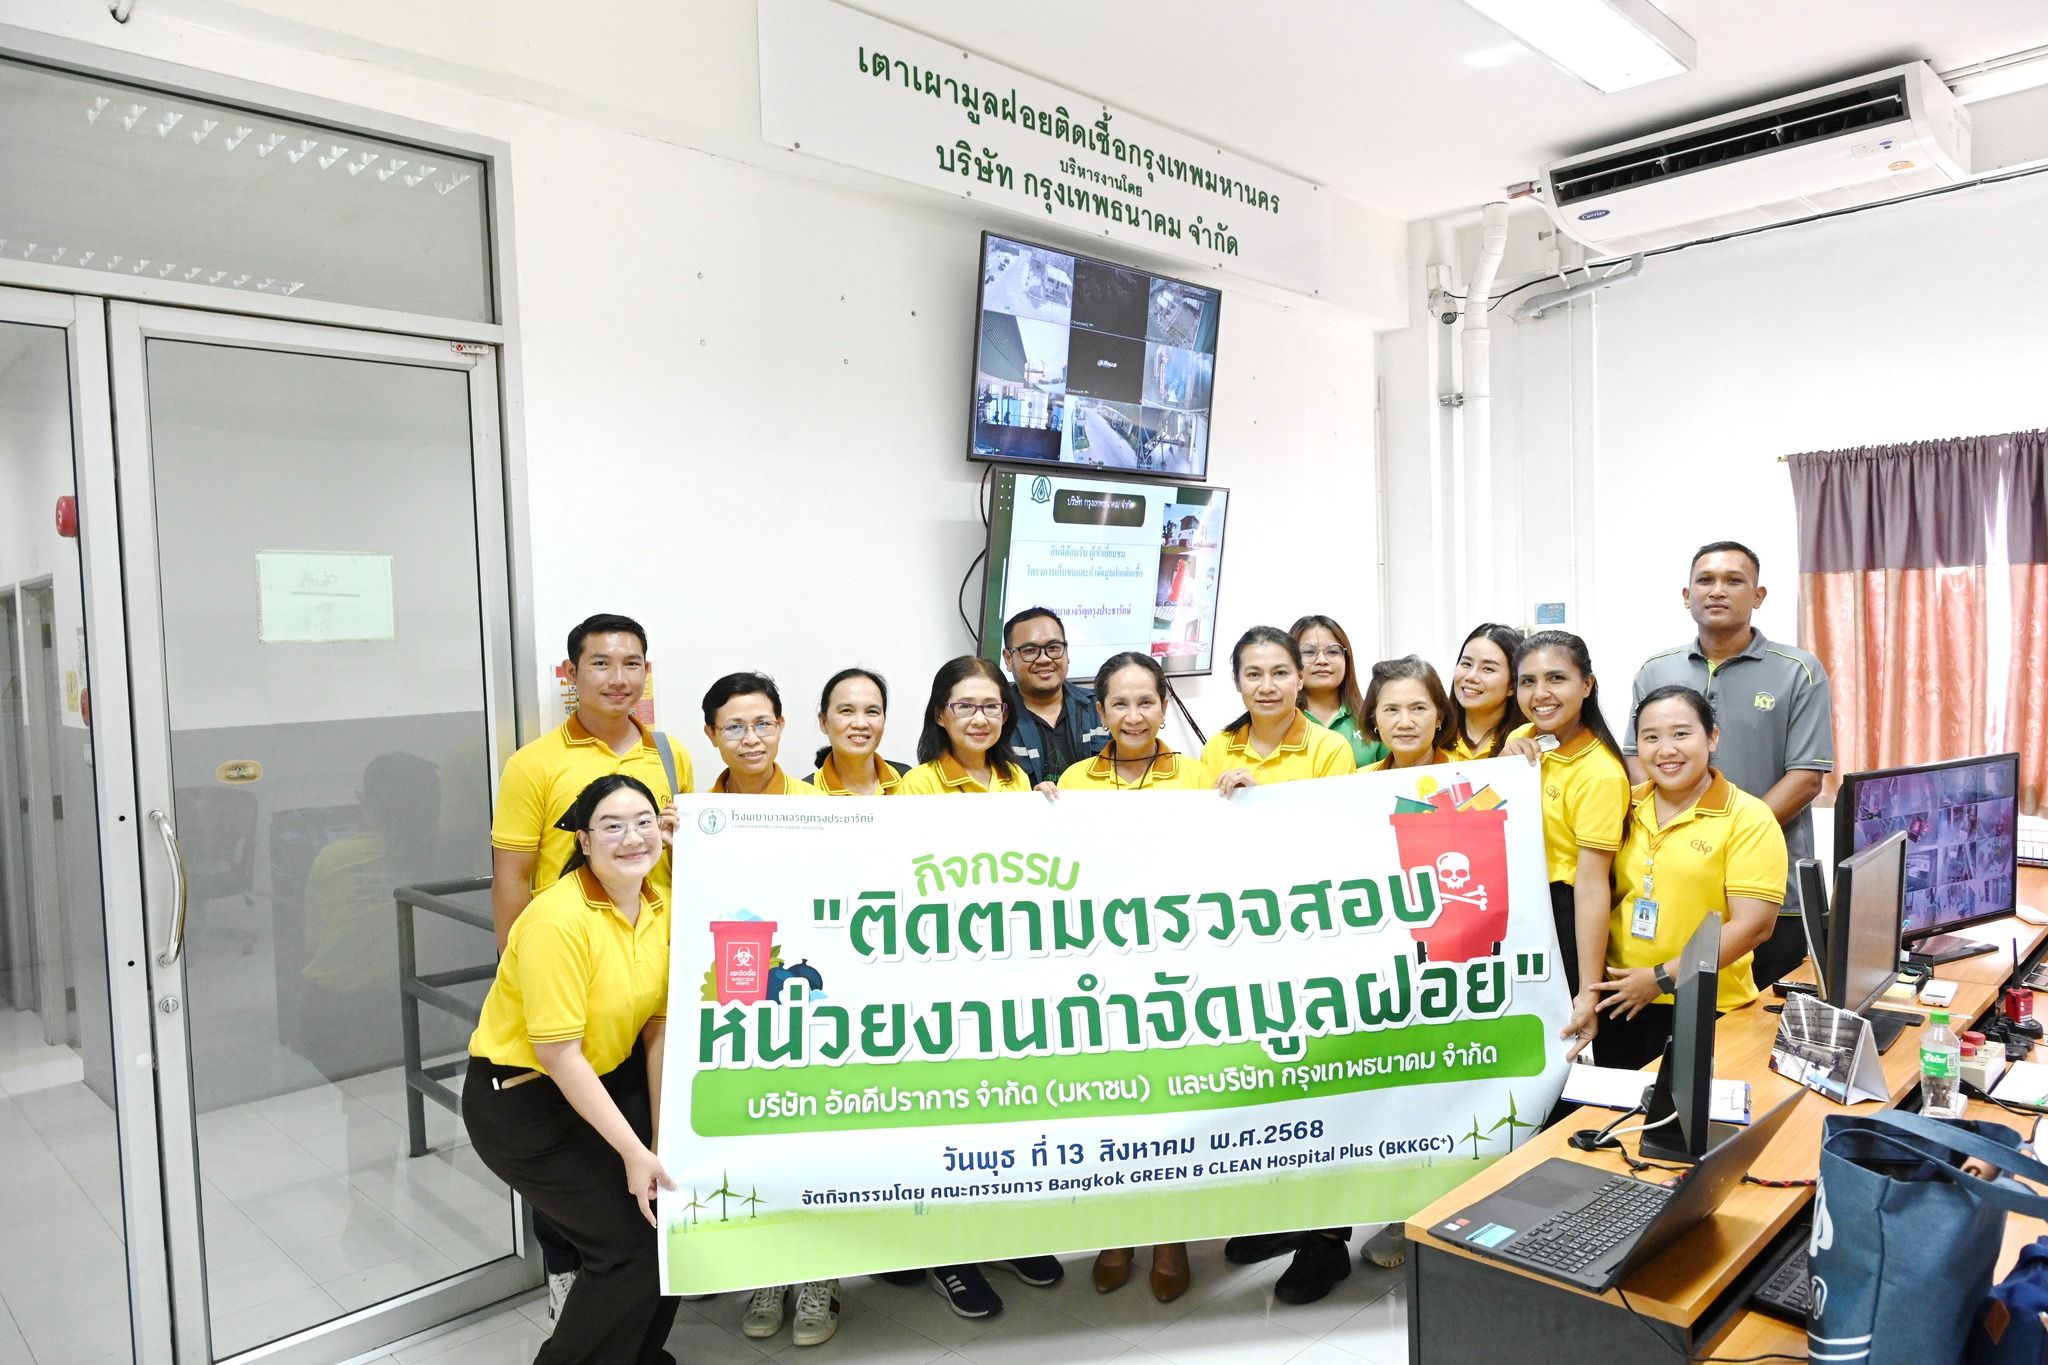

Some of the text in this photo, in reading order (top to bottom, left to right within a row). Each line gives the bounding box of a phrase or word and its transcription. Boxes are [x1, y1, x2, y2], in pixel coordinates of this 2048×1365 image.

[858, 45, 1281, 214] เตาเผามูลฝอยติดเชื้อกรุงเทพมหานคร
[935, 139, 1240, 257] บริษัท กรุงเทพธนาคม จำกัด
[1059, 157, 1144, 198] บริหารงานโดย
[731, 809, 875, 827] โรงพยาบาลเจริญกรุงประชารักษ์
[911, 850, 1081, 897] กิจกรรม
[747, 1089, 817, 1119] บริษัท
[824, 1083, 970, 1116] อัคคีปราการ
[975, 1079, 1038, 1109] จำกัด
[1045, 1075, 1151, 1106] (มหาชน)
[1167, 1065, 1274, 1097] และบริษัท
[1442, 1040, 1498, 1069] จำกัด
[801, 1183, 925, 1206] จัดกิจกรรมโดย
[930, 1178, 1043, 1201] คณะกรรมการ
[1049, 1171, 1125, 1192] Bangkok
[1130, 1165, 1188, 1184] GREEN
[1192, 1163, 1204, 1177] &
[1208, 1157, 1262, 1176] CLEAN
[1267, 1149, 1335, 1169] Hospital
[1339, 1142, 1373, 1160] Plus
[943, 1119, 1325, 1176] วันพุธ ที่ 13 สิงหาคม พ.ศ.2568
